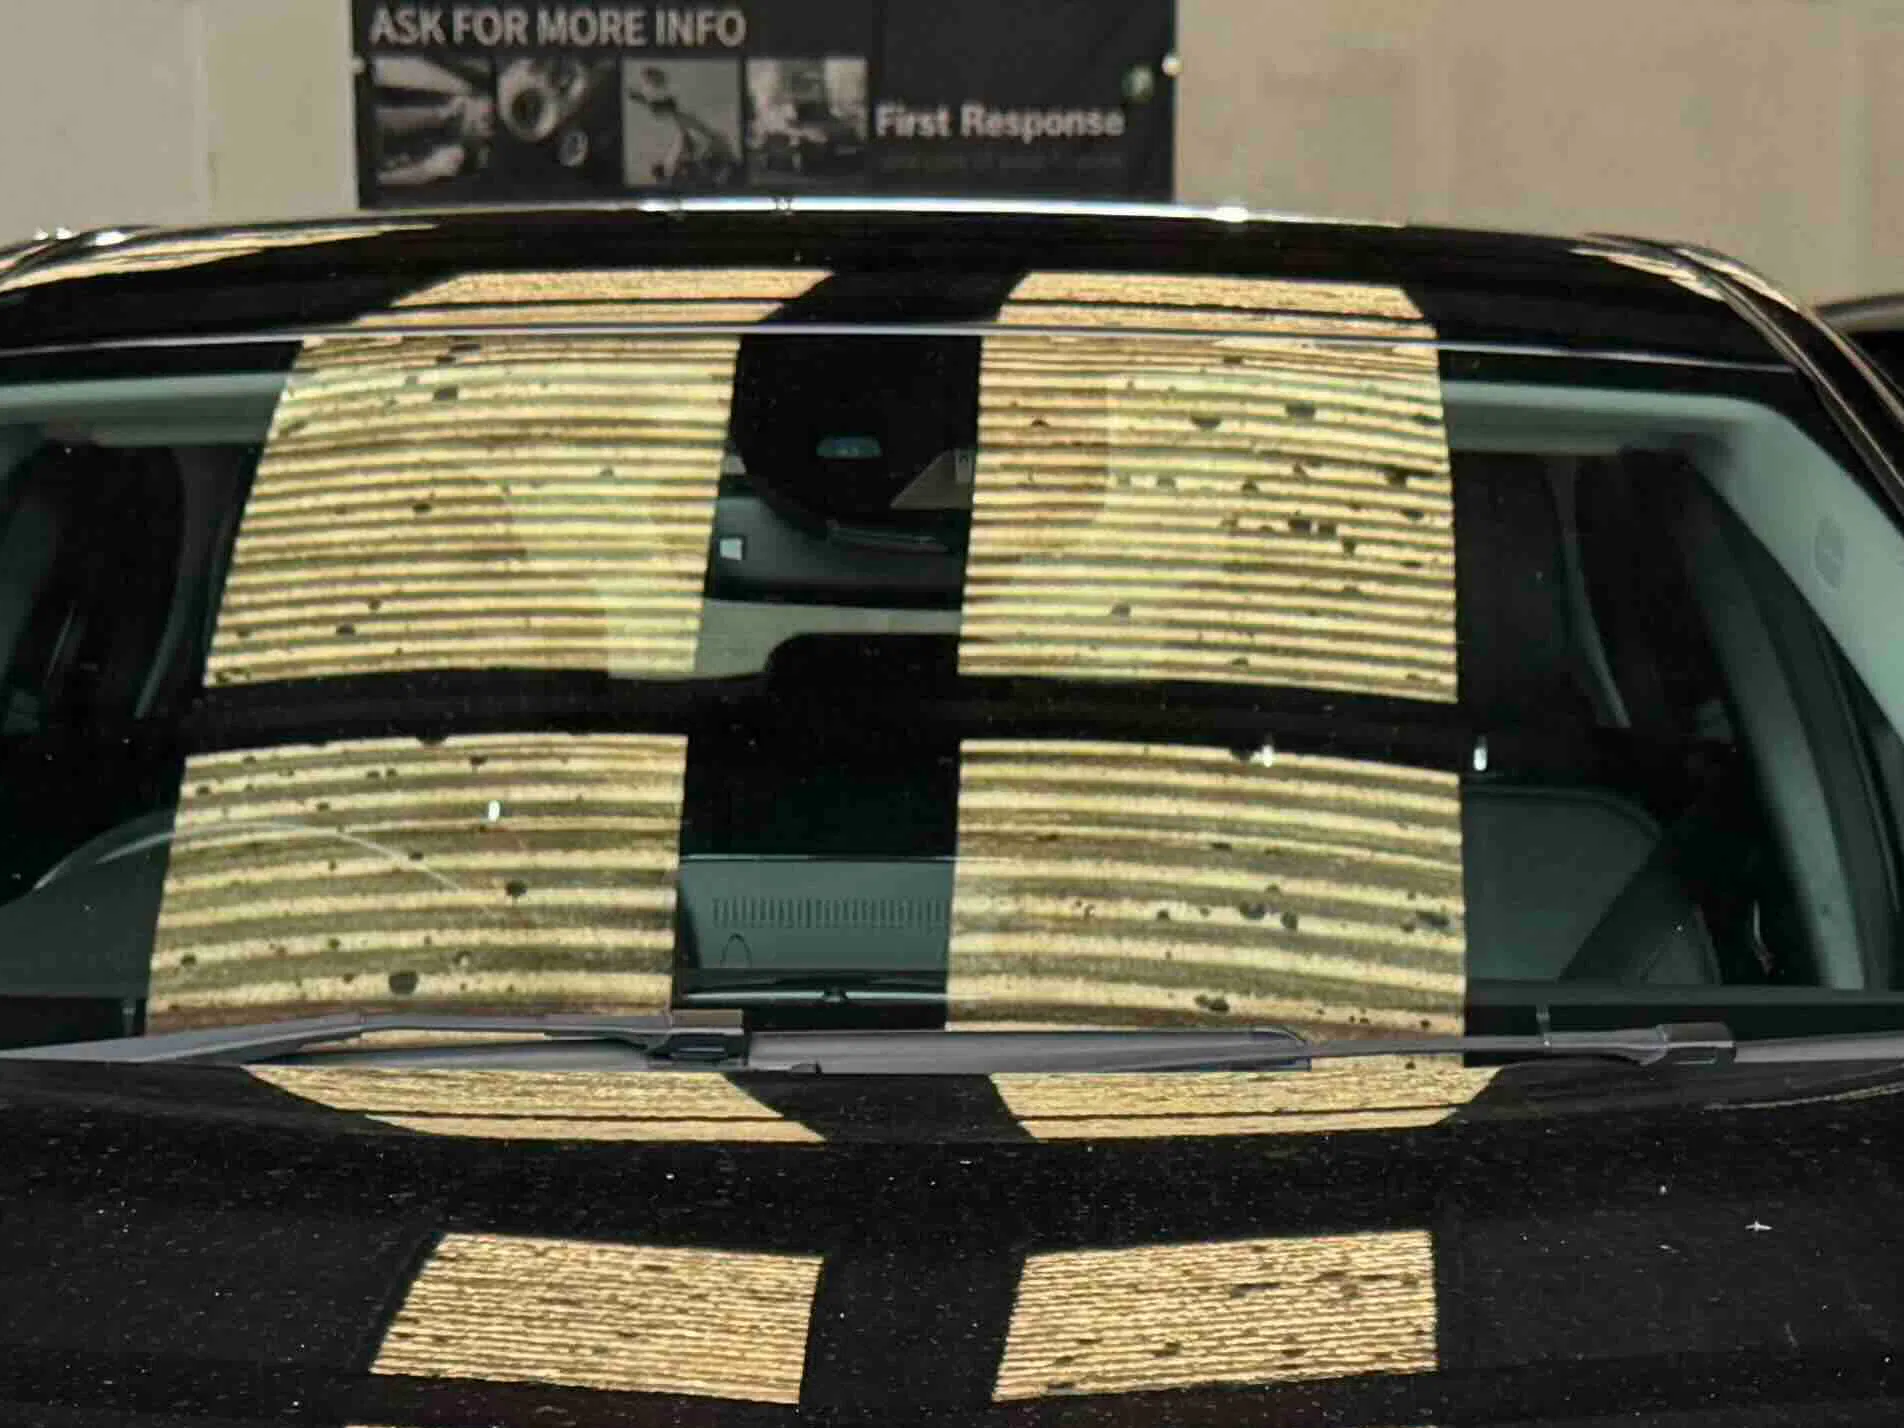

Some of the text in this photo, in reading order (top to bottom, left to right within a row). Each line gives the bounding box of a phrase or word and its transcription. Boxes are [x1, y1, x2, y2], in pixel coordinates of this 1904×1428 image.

[368, 7, 747, 46] ASK FOR MORE INFO
[875, 102, 1127, 145] First Response
